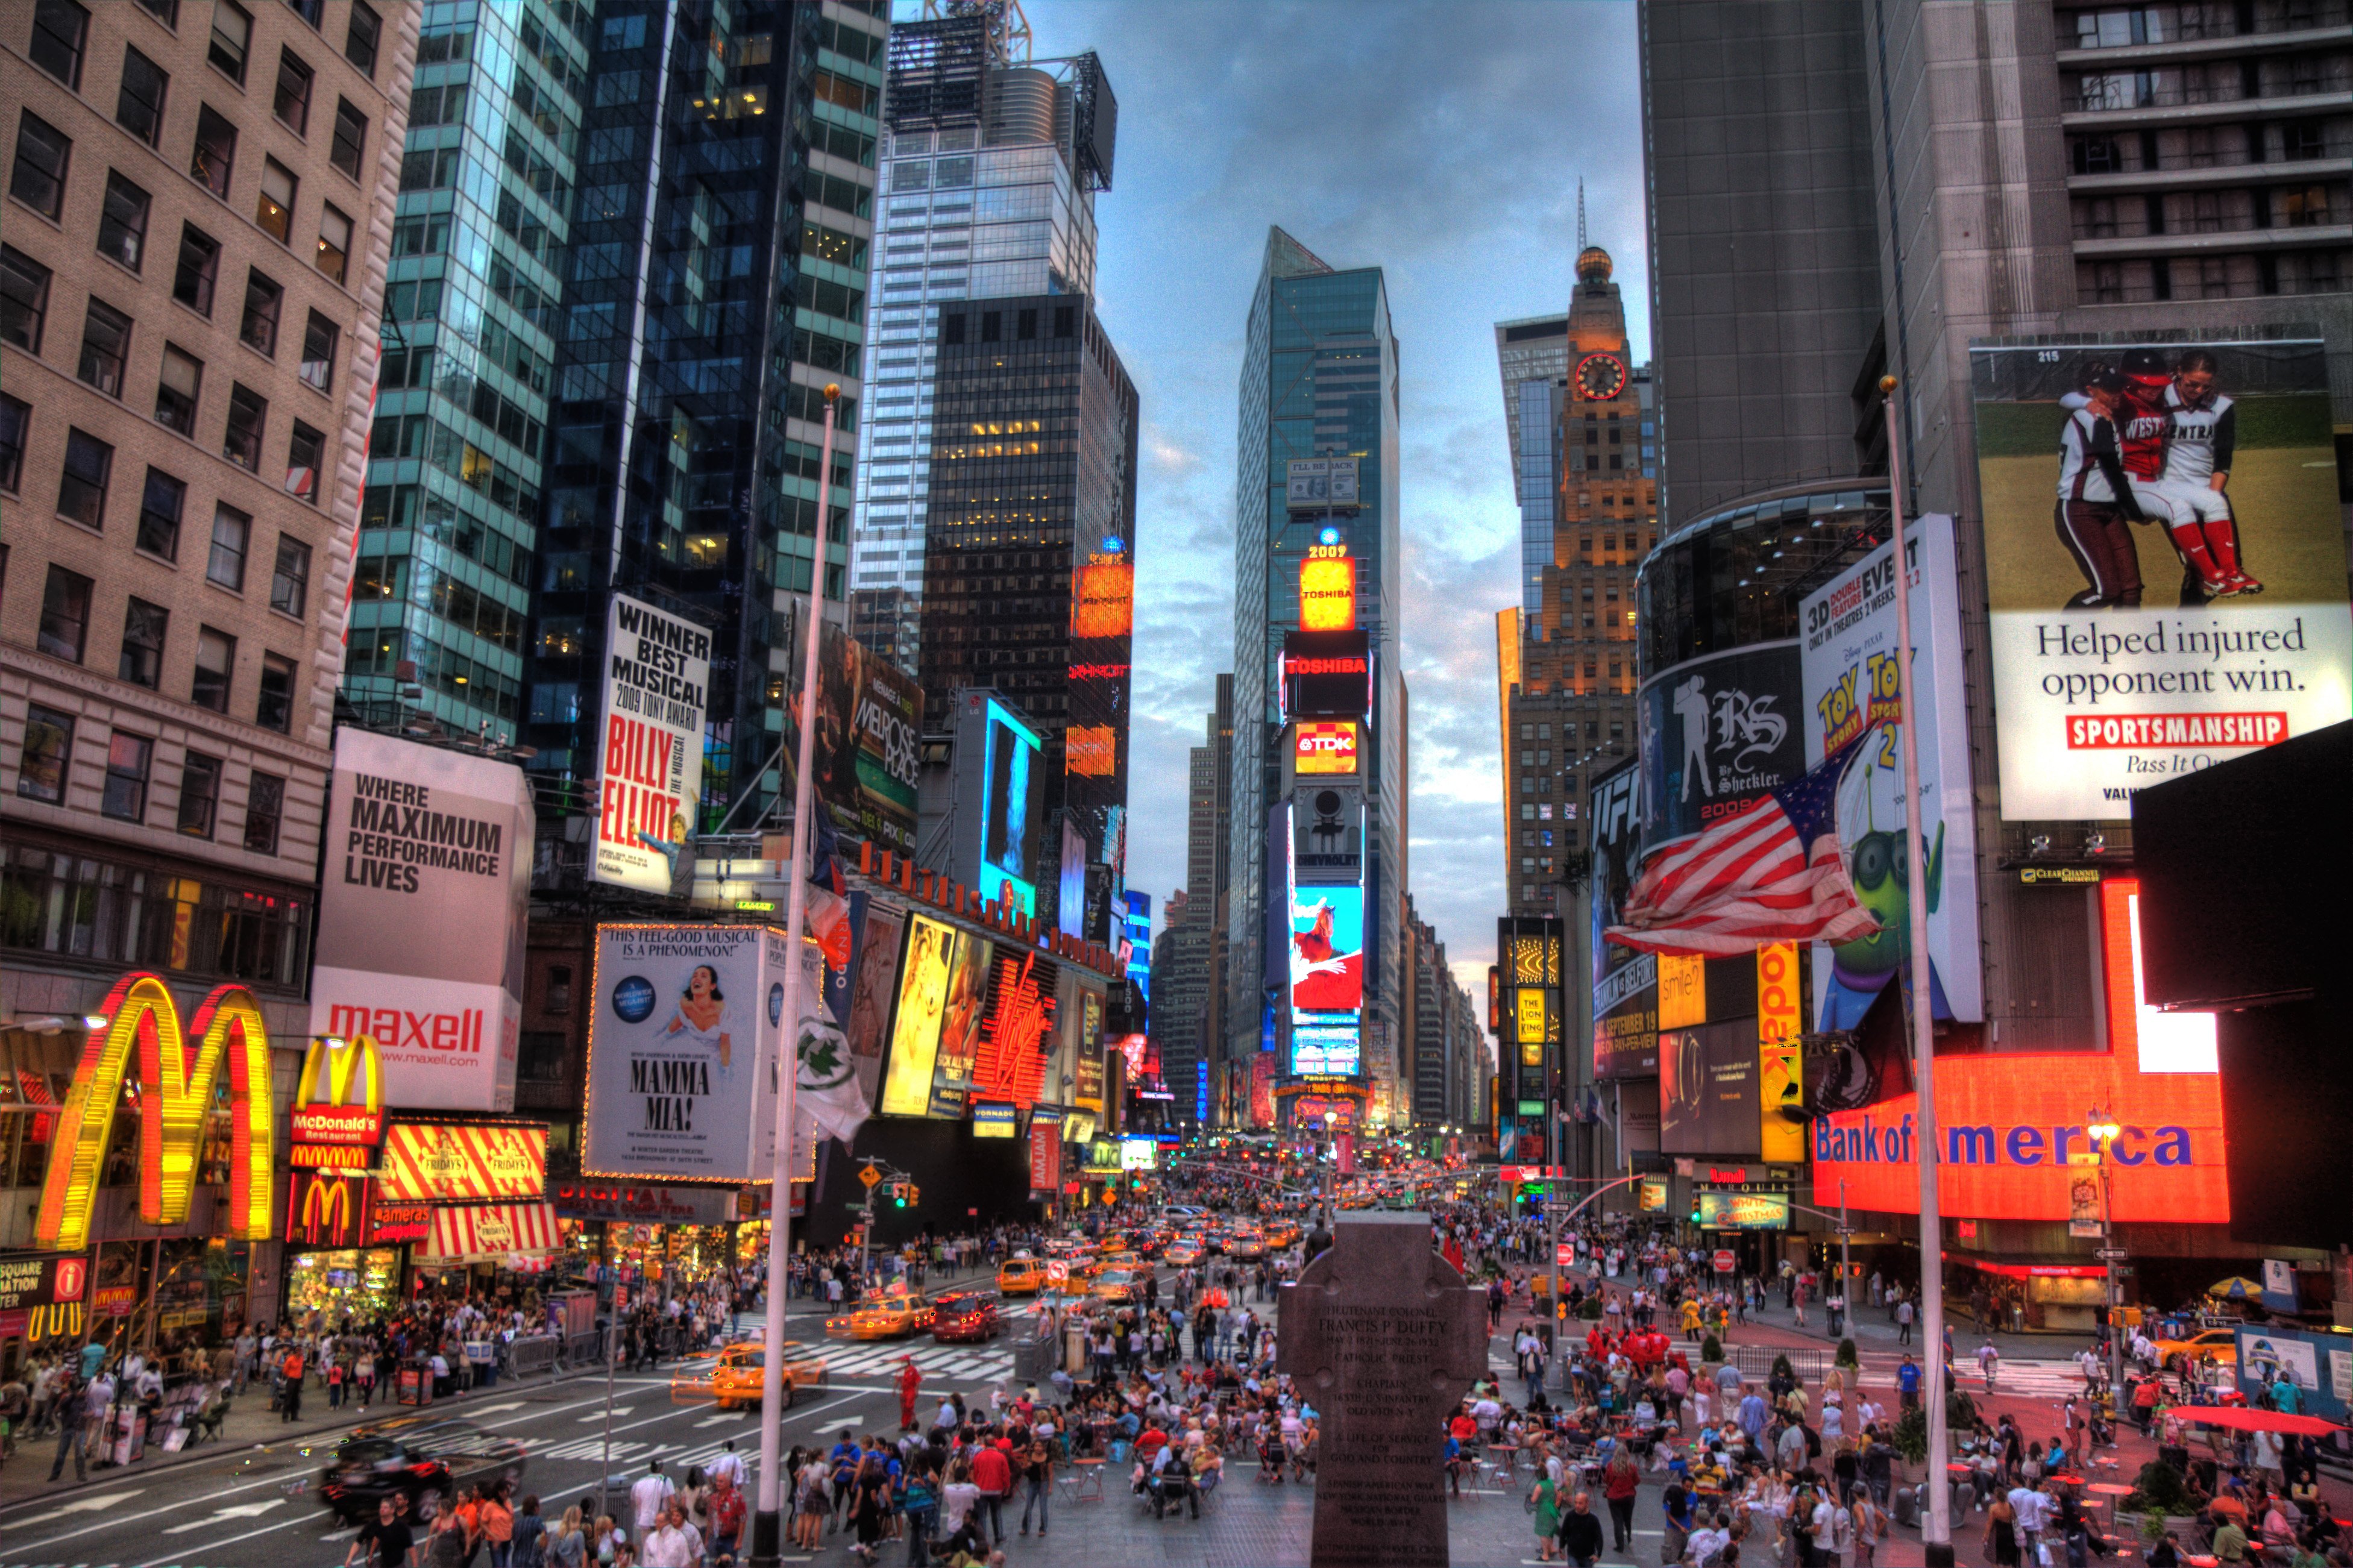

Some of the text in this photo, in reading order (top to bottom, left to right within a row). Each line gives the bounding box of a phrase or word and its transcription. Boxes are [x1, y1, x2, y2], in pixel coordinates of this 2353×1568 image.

[2038, 351, 2060, 362] 215
[1309, 545, 1347, 558] 2009
[1862, 536, 1918, 598] EVET
[1303, 590, 1352, 599] TOSHIBA
[1830, 575, 1861, 606] DOUBLE
[1831, 589, 1862, 619] FEATURE
[1808, 598, 1829, 635] 3D
[1809, 586, 1896, 651] ONLY IN THEATRES 2 WEEKS.
[617, 601, 709, 662] WINNER
[2035, 617, 2307, 665] Helped injured
[637, 638, 688, 678] BEST
[1844, 632, 1883, 662] Disney PIXAR
[1286, 658, 1366, 674] TOSHIBA
[612, 655, 705, 709] MUSICAL
[2042, 659, 2307, 704] opponent win.
[616, 683, 697, 733] 2009 TONY AWARD
[1818, 662, 1859, 736] TOY
[854, 697, 916, 757] MELROSE
[1712, 687, 1788, 772] RS
[1826, 716, 1859, 754] STORY
[2073, 717, 2281, 745] SPORTSMANSHIP
[606, 713, 673, 791] BILLY
[1312, 737, 1352, 751] TDK
[1878, 720, 1897, 771] 2
[671, 735, 686, 795] THE MUSICAL
[884, 739, 919, 790] PLACE
[1718, 765, 1732, 777] By
[2126, 754, 2187, 773] Pass It
[356, 772, 429, 808] WHERE
[1718, 772, 1780, 794] Sheckler
[600, 779, 680, 854] ELLIOT
[1701, 798, 1752, 820] 2009
[351, 797, 502, 854] MAXIMUM
[347, 831, 499, 877] PERFORMANCE
[1296, 853, 1359, 866] CHEVROLET
[344, 856, 419, 894] LIVES
[1016, 891, 1025, 913] LG
[639, 930, 702, 943] FEEL-GOOD
[706, 931, 758, 944] MUSICAL
[623, 944, 633, 956] IS
[637, 944, 645, 956] A
[1594, 976, 1619, 1012] FRANKLIN
[1625, 956, 1656, 993] BELFORT
[1663, 964, 1700, 1001] smile?
[1524, 999, 1538, 1008] THE
[1521, 1009, 1541, 1021] LION
[1607, 1012, 1644, 1037] SEPTEMBER
[1646, 1010, 1656, 1031] 19
[330, 1003, 483, 1053] maxell
[1521, 1023, 1542, 1035] KING
[1595, 1033, 1657, 1055] LIVE ON PAY-PER-VIEW
[382, 1052, 479, 1067] ww.maxell.com
[950, 1056, 963, 1069] ALL
[963, 1057, 975, 1070] THE
[629, 1059, 711, 1096] MAMMA
[293, 1115, 377, 1131] McDonald's
[644, 1097, 693, 1132] MIA!
[306, 1131, 361, 1141] Restaurant
[1815, 1111, 2192, 1167] Bank of merica
[638, 1146, 657, 1154] WINTER
[1034, 1131, 1046, 1186] JAMJAM
[559, 1185, 674, 1204] DIGITAL
[1700, 1184, 1789, 1194] MARQUIS
[1729, 1195, 1767, 1209] WHITE
[1717, 1206, 1783, 1226] CHRISTMAS
[0, 1261, 43, 1279] SQUARE
[1327, 1305, 1437, 1318] LIEUTENANT COLONEL
[1318, 1318, 1448, 1334] FRANCIS P DUFFY
[1334, 1353, 1430, 1364] CATHOLIC PRIEST
[1357, 1379, 1407, 1389] CHAPLAIN
[1346, 1406, 1368, 1416] OLD
[1346, 1434, 1368, 1443] LIFE
[1371, 1434, 1385, 1443] OF
[1389, 1434, 1430, 1444] SERVICE
[1330, 1454, 1433, 1465] GOD AND COUNTRY
[1327, 1480, 1363, 1489] SPANISH
[1364, 1481, 1412, 1490] AMERICAN
[1339, 1493, 1364, 1502] YORK
[1368, 1494, 1409, 1502] NATIONAL
[1414, 1494, 1446, 1504] GUARD
[1350, 1518, 1384, 1526] WORLD
